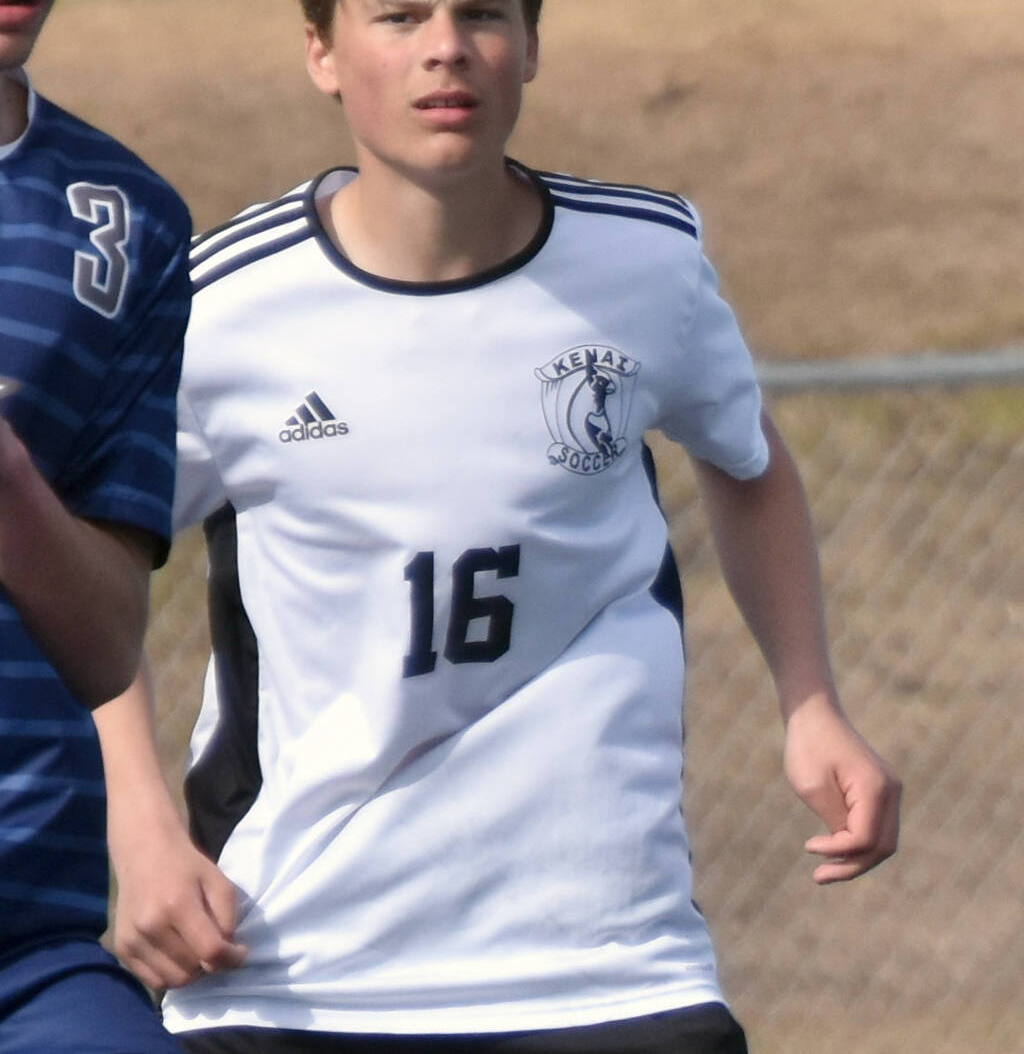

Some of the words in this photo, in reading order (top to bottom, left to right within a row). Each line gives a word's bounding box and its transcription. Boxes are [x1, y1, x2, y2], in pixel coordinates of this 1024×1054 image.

[66, 181, 130, 319] 3
[552, 348, 628, 376] KENAI
[279, 421, 349, 443] adidas
[402, 543, 521, 678] 16
